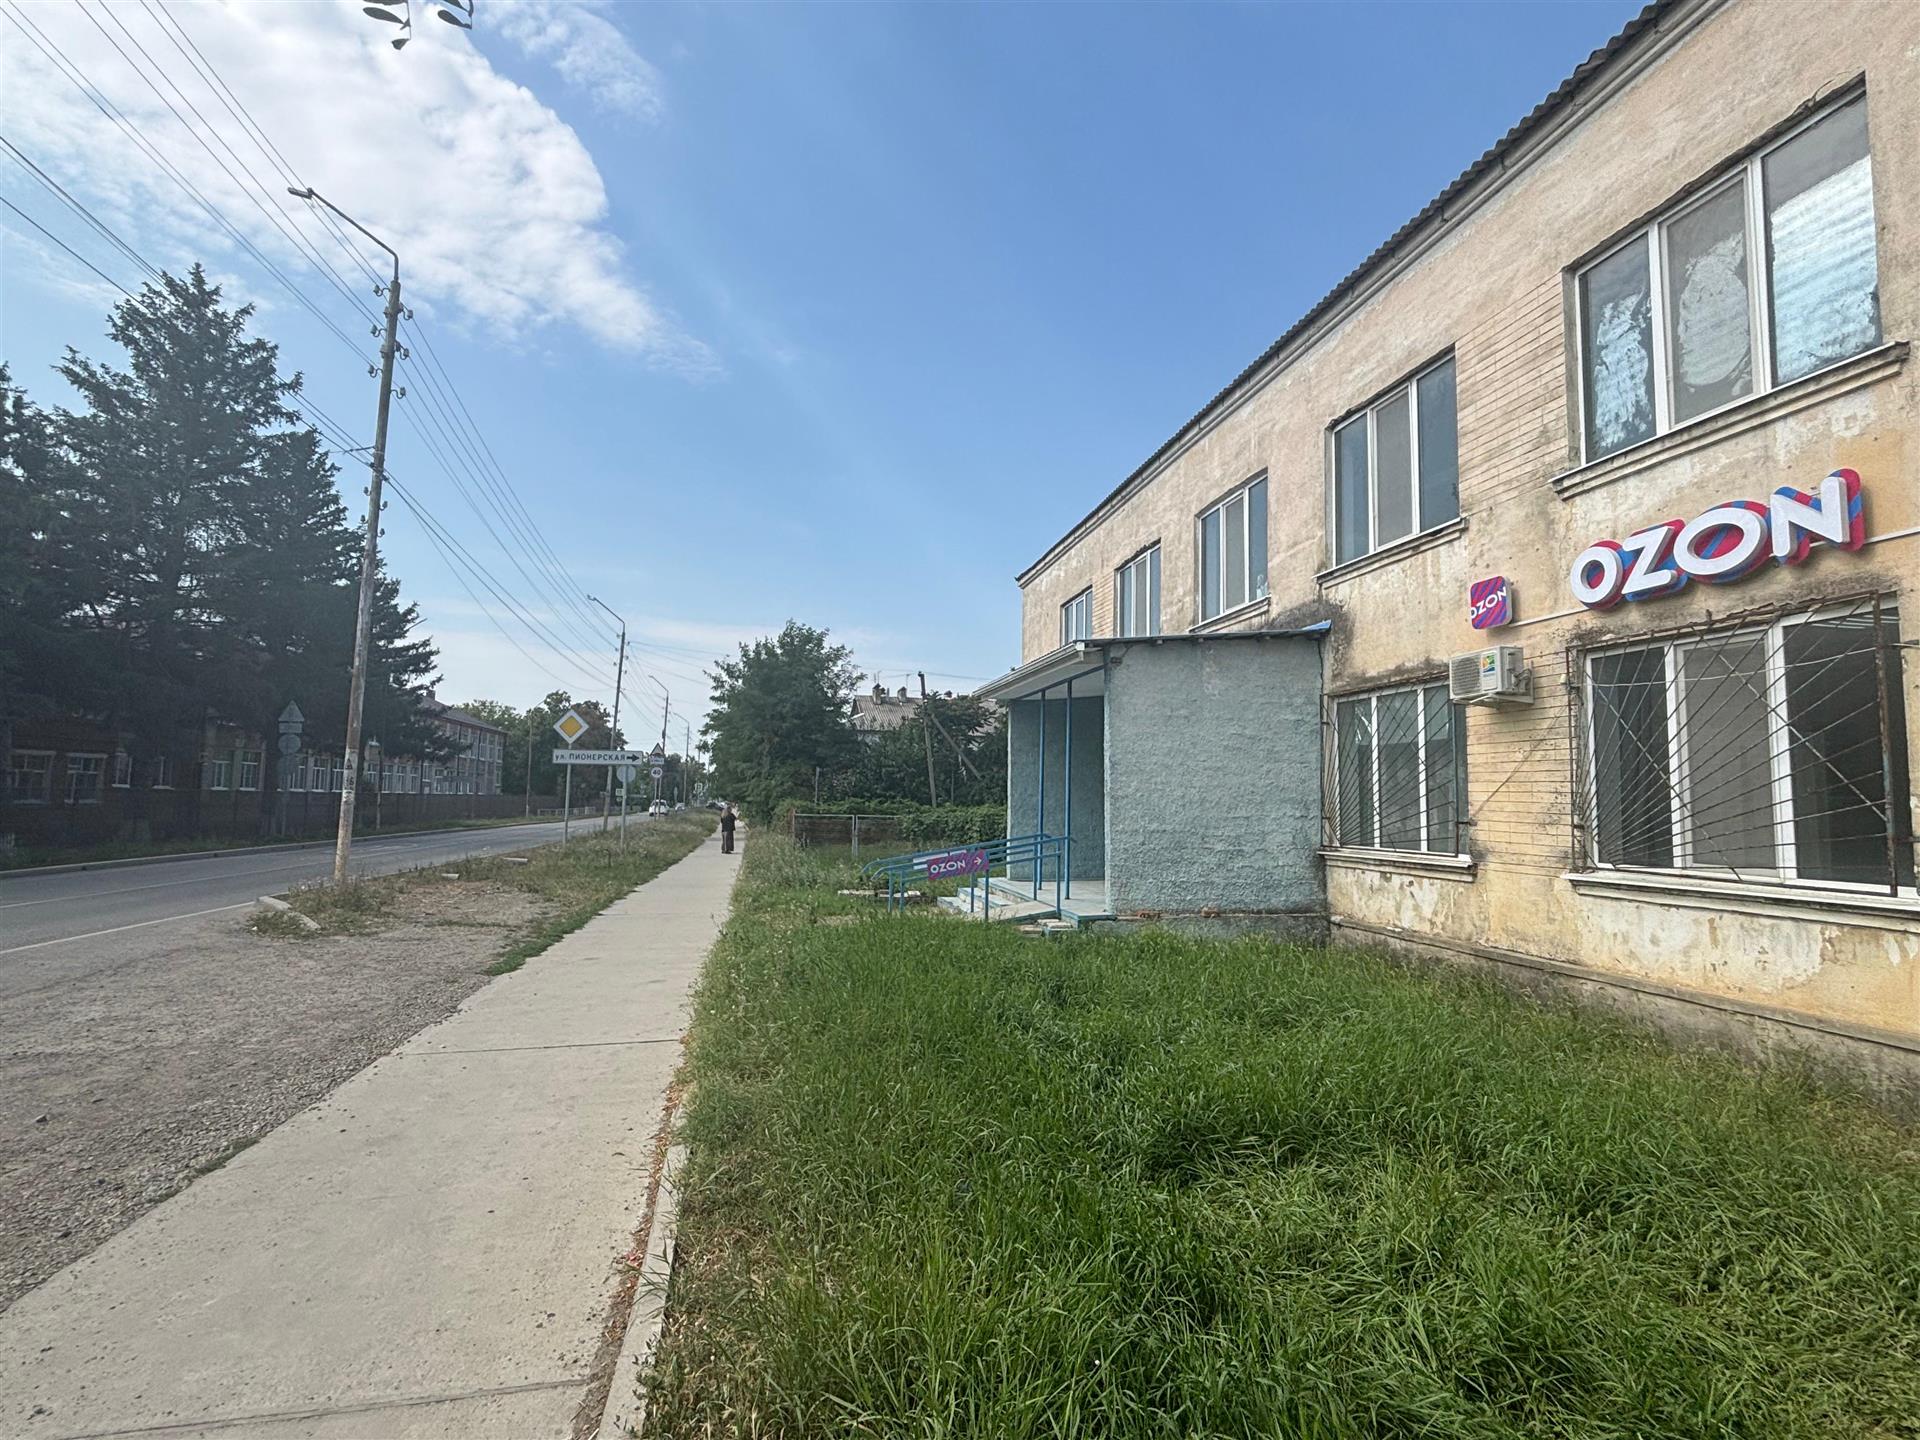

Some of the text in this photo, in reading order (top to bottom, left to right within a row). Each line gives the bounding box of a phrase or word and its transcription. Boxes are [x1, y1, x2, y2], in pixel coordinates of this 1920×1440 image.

[1570, 476, 1850, 604] OZON
[554, 753, 625, 761] ул. ПИОНЕРСКАЯ
[930, 860, 965, 873] OZON
